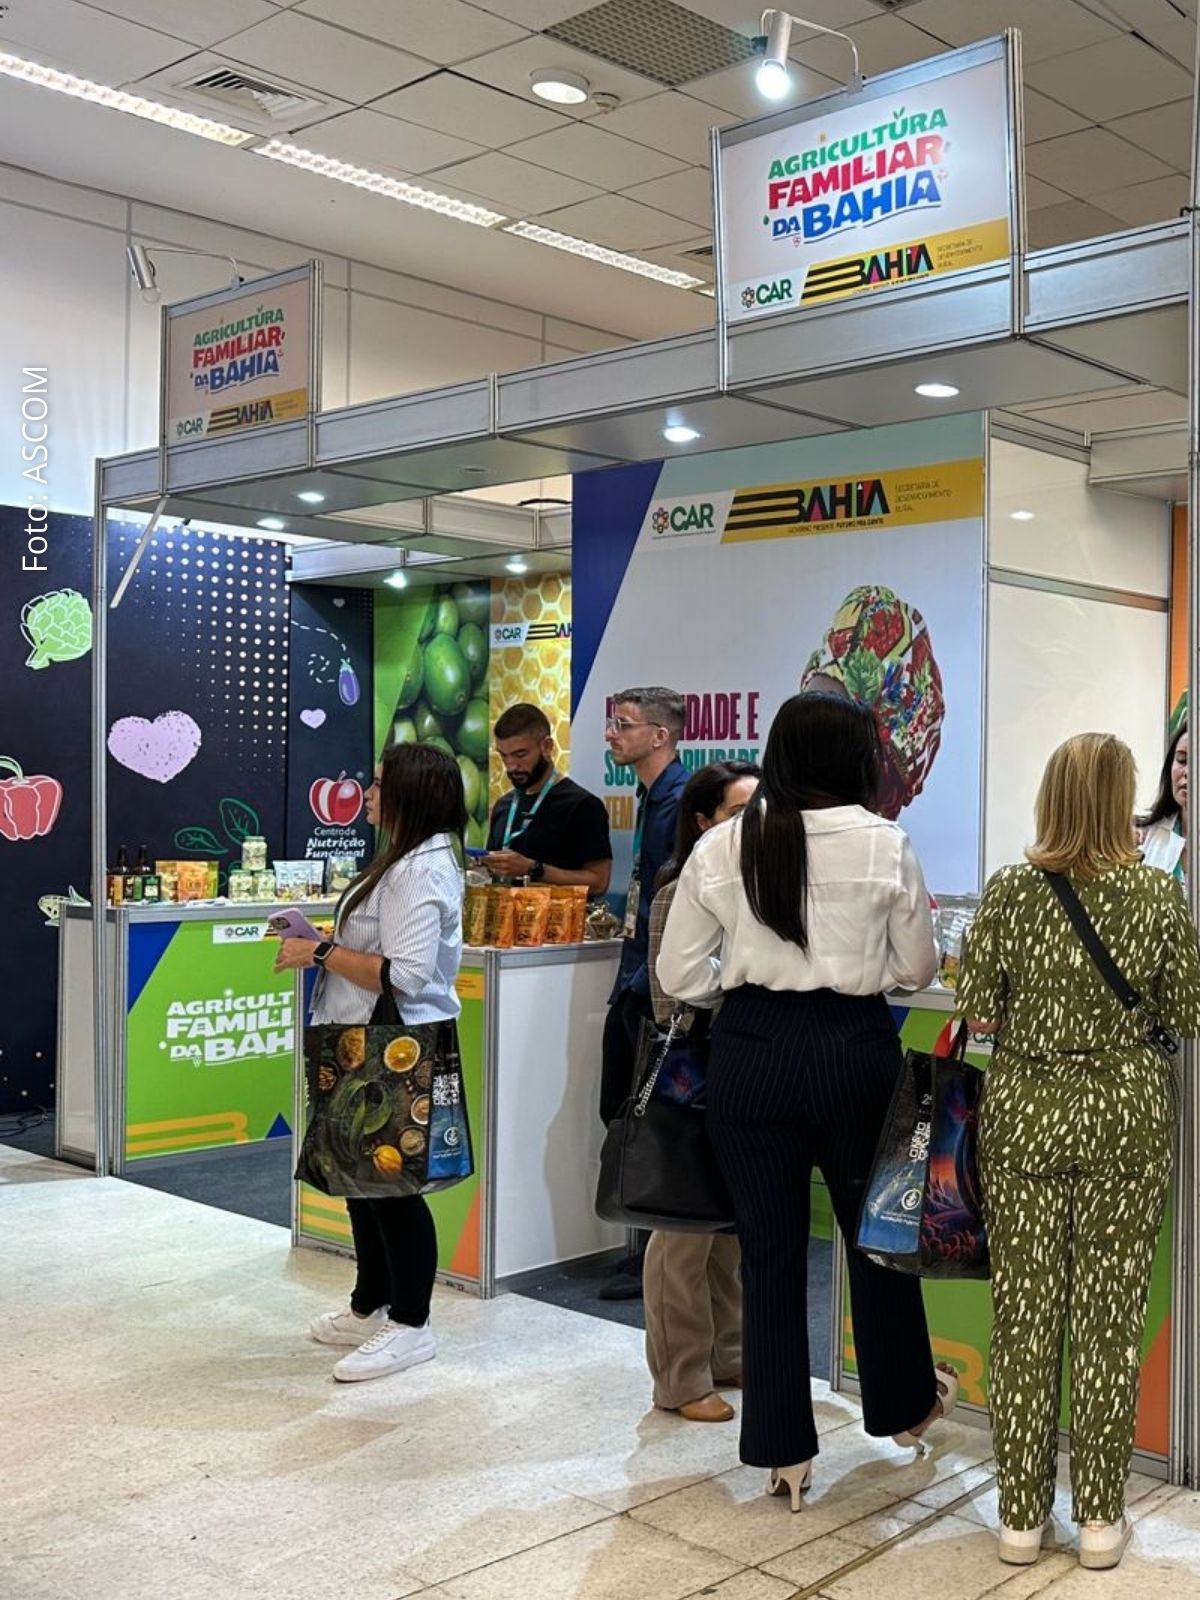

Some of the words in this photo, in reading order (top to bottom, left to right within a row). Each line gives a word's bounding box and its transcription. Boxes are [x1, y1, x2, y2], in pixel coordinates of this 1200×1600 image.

[767, 108, 948, 180] AGRICULTURA
[769, 134, 943, 210] FAMILIAR
[772, 216, 801, 237] DA
[802, 169, 942, 239] BAHIA
[756, 278, 793, 305] CAR
[193, 306, 285, 347] AGRICULTURA
[192, 325, 282, 369] FAMILIAR
[209, 349, 280, 390] BAHIA
[183, 417, 204, 435] CAR
[670, 502, 715, 532] CAR
[502, 626, 522, 640] CAR
[747, 691, 760, 741] E
[306, 836, 366, 850] Nutrição
[234, 926, 259, 937] CAR
[166, 990, 295, 1017] AGRICULT
[166, 1007, 294, 1039] FAMILI
[170, 1044, 202, 1059] DA
[204, 1028, 295, 1063] BAH
